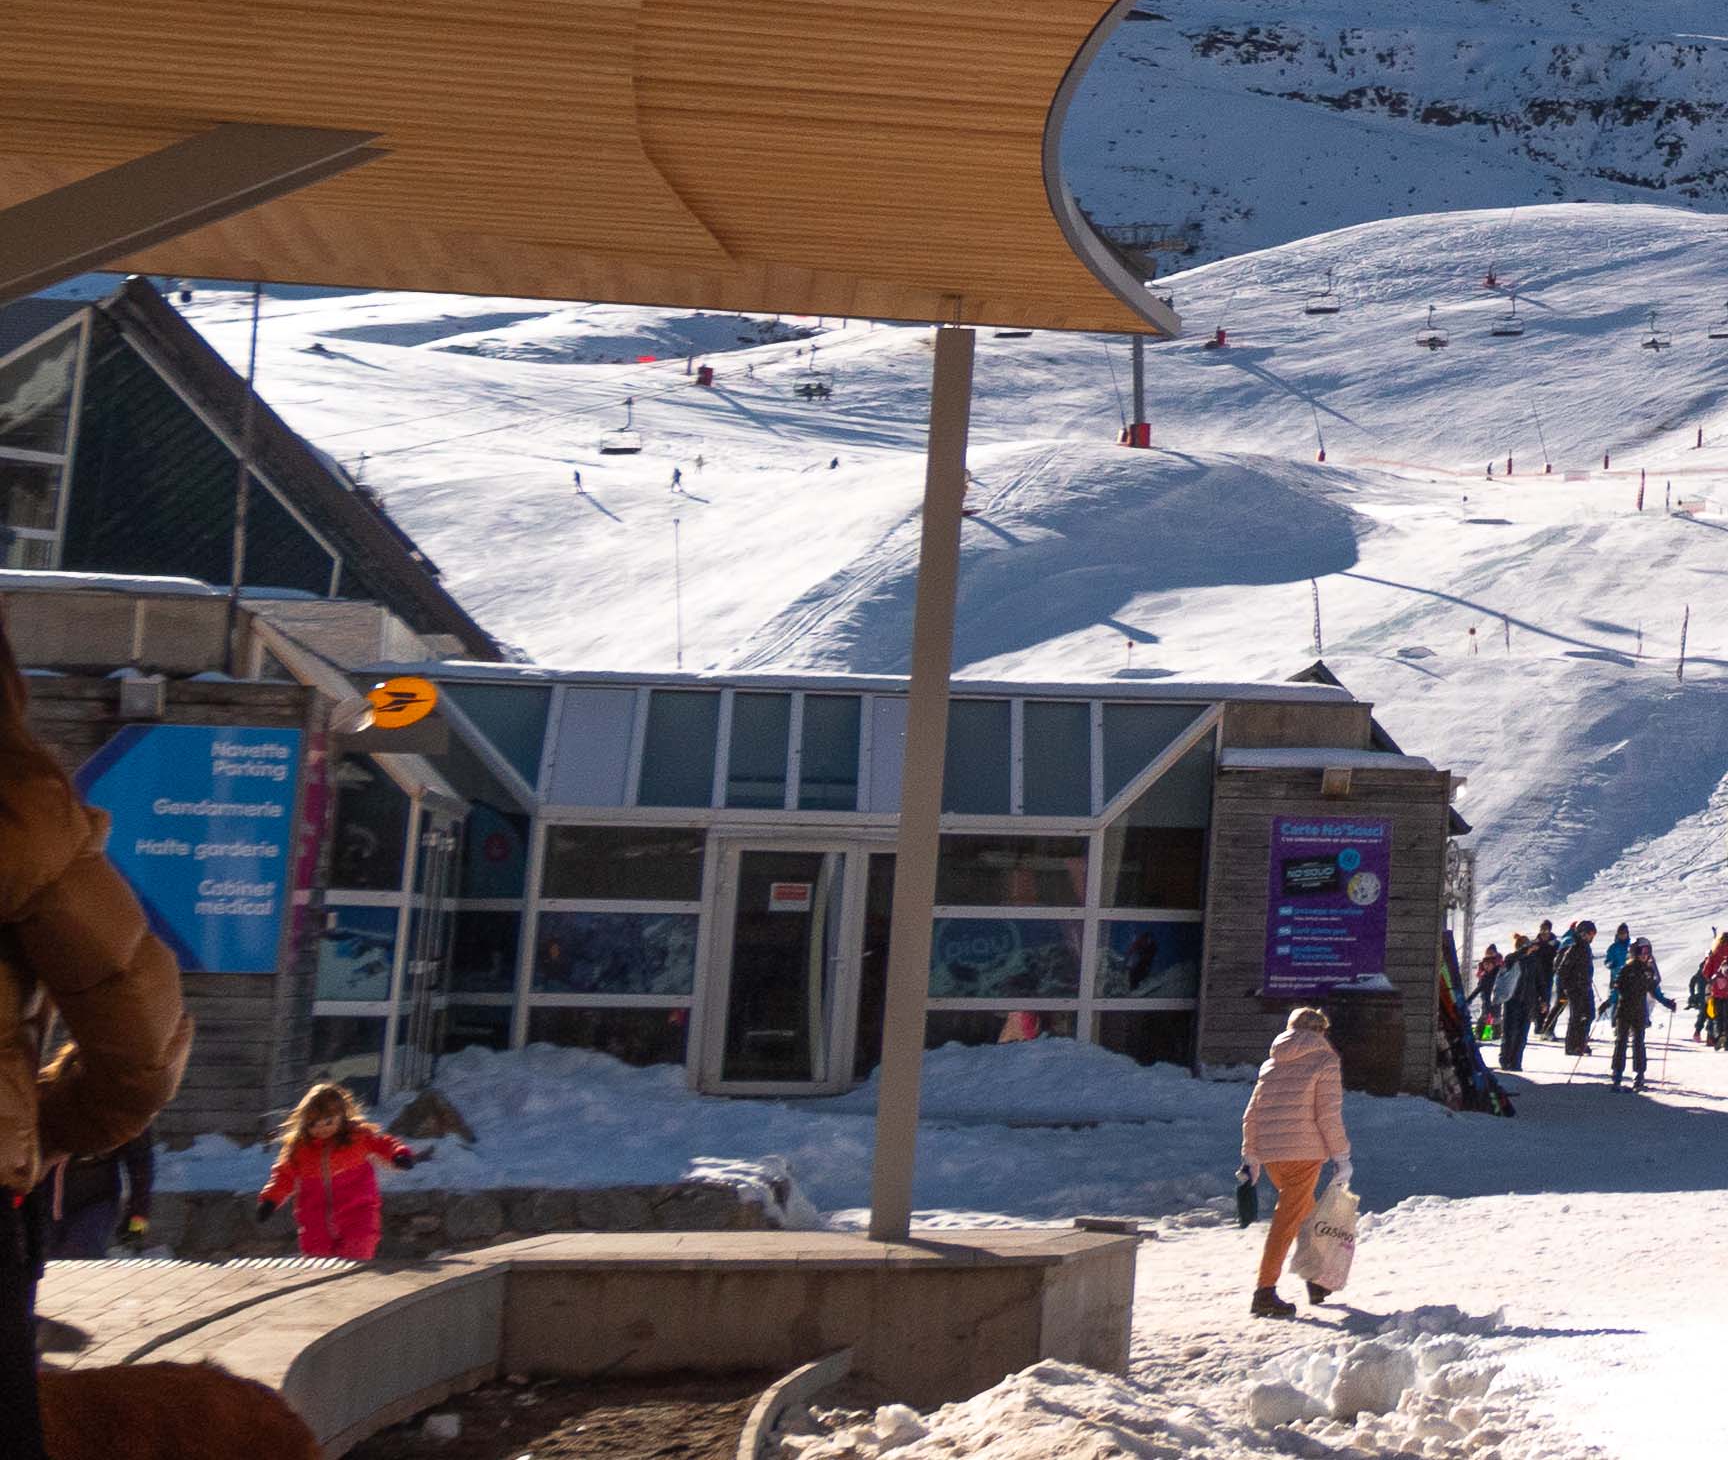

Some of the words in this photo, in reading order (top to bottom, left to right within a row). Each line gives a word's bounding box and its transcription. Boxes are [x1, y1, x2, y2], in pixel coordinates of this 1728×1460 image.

[211, 740, 290, 759] Navette
[211, 760, 288, 781] Parking
[153, 797, 284, 817] Gendarmerie
[193, 840, 280, 860] garderie
[197, 878, 276, 897] Cabinet
[194, 898, 275, 915] médical
